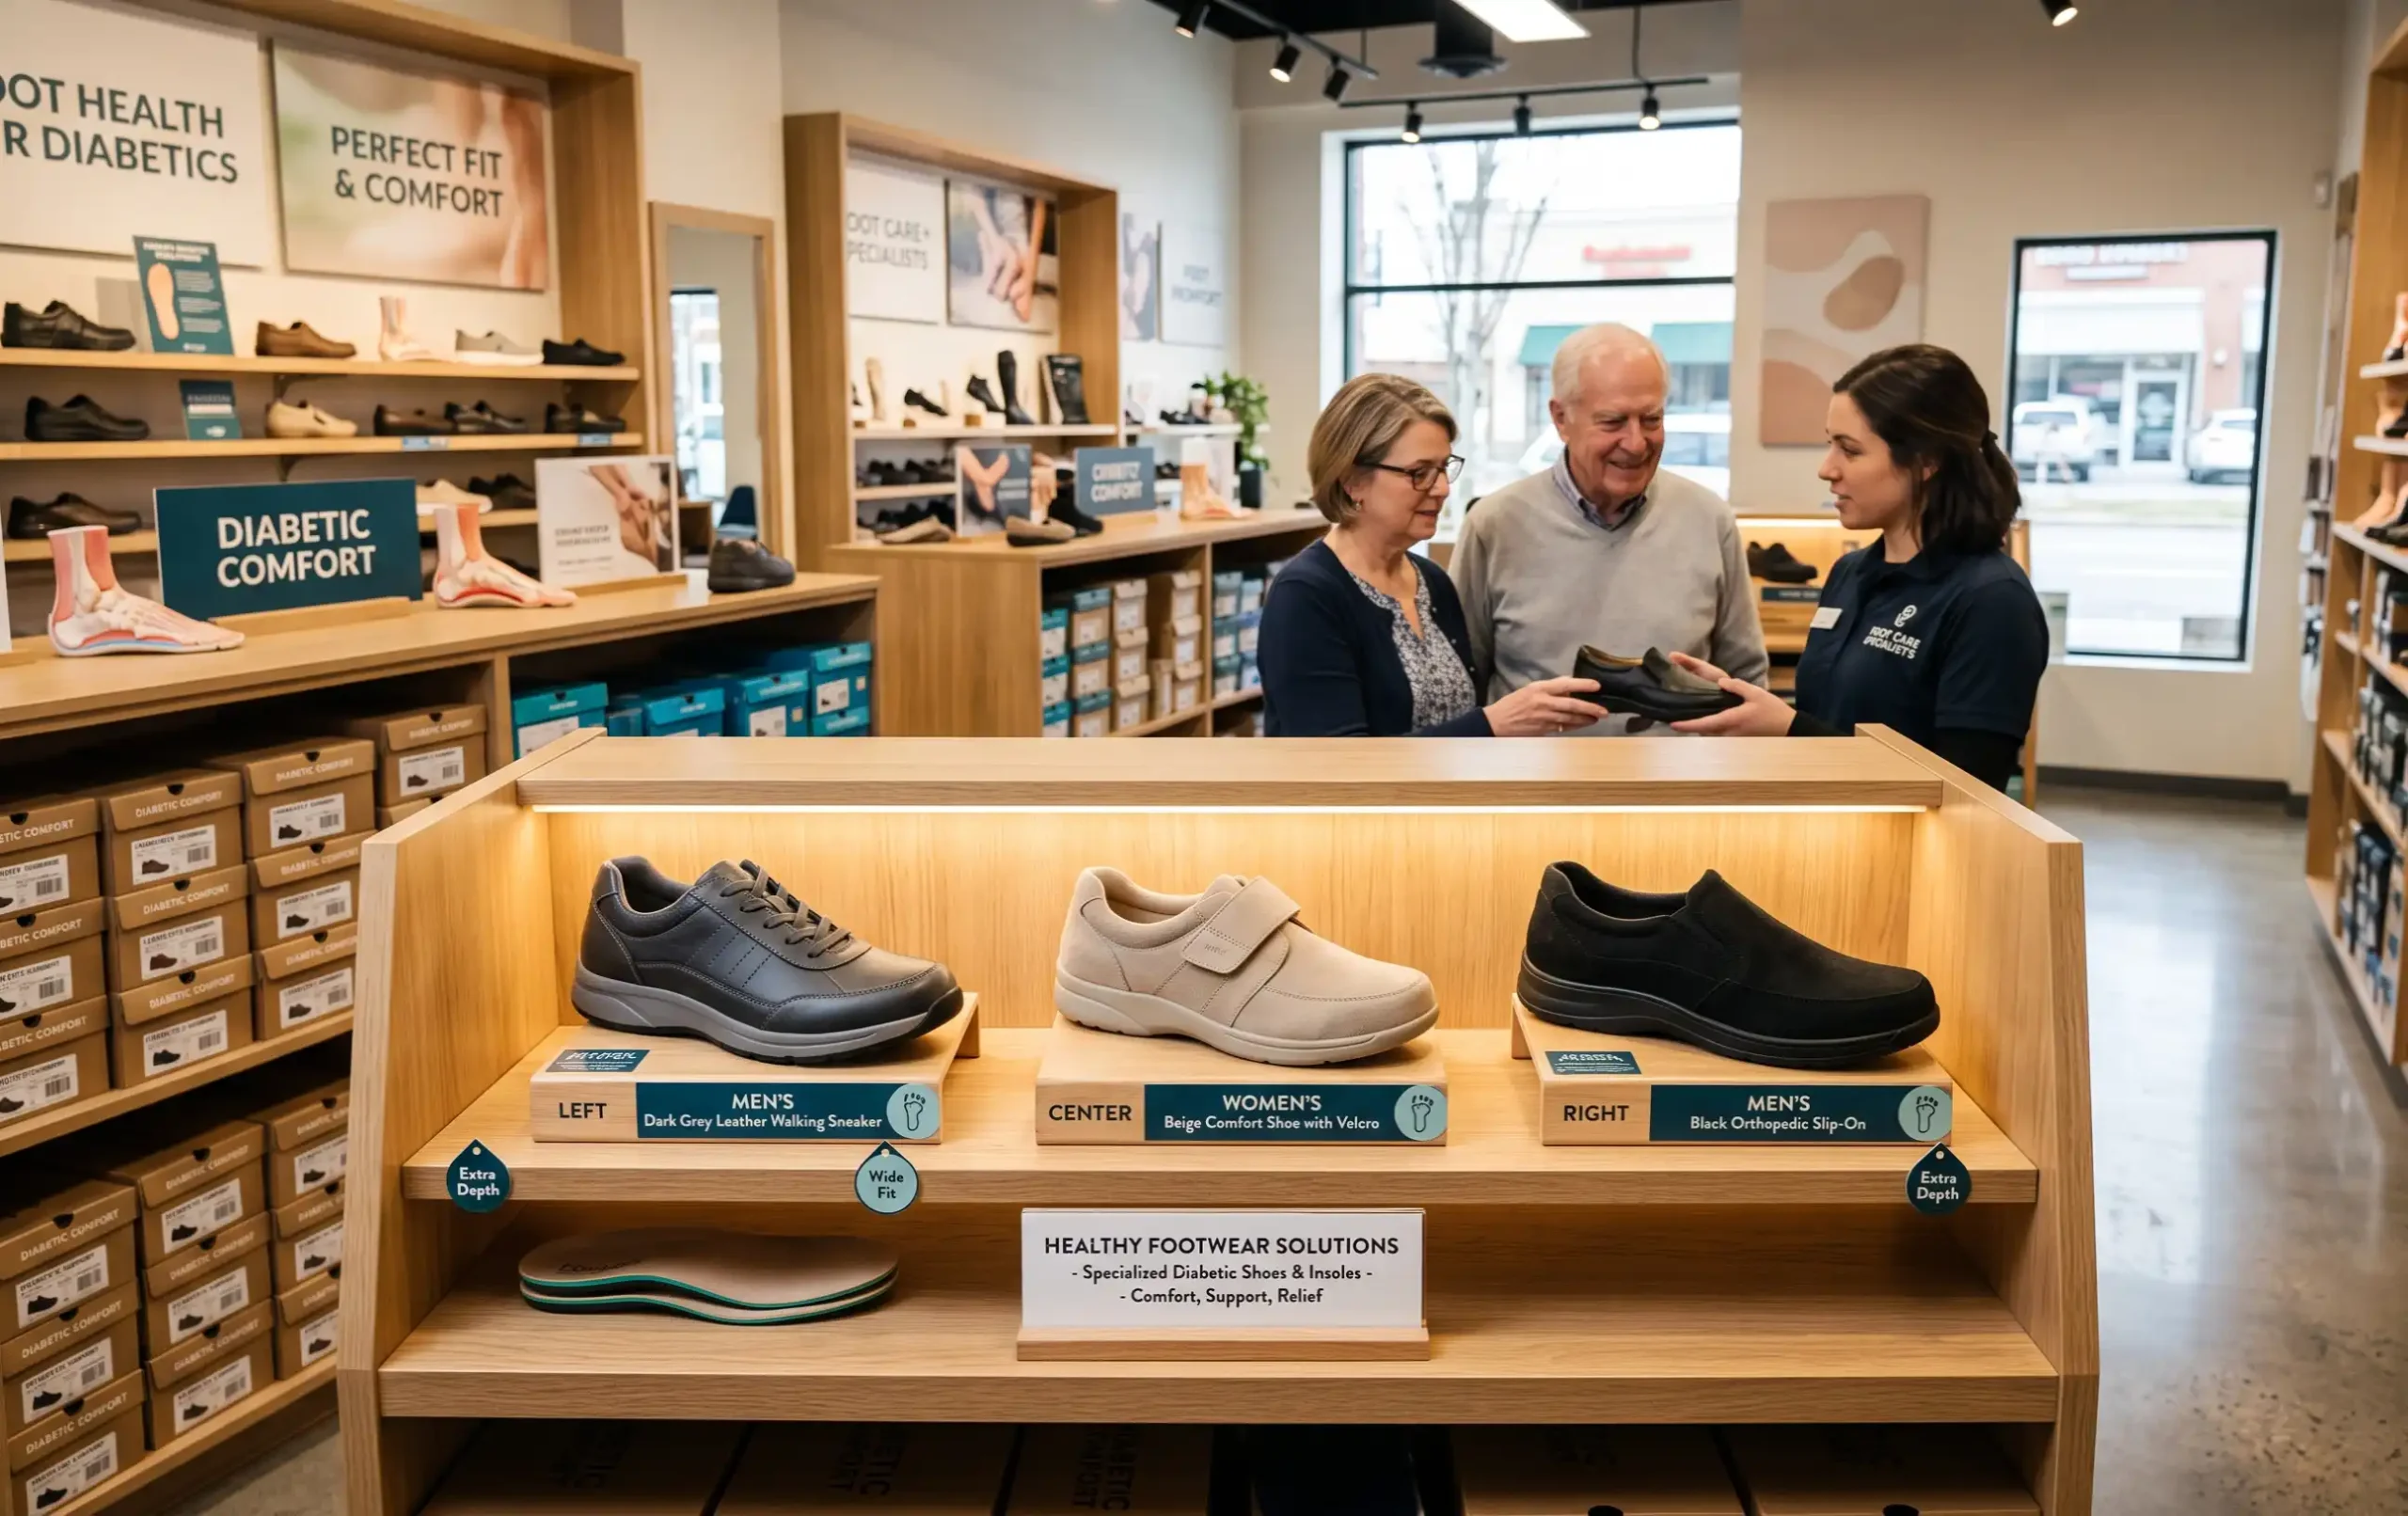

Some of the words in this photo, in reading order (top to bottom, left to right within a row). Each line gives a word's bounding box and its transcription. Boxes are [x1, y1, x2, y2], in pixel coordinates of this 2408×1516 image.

[0, 73, 65, 114] OT
[77, 84, 224, 139] HEALTH
[42, 125, 239, 184] DIABETICS
[331, 125, 456, 173] PERFECT
[465, 147, 503, 180] FIT
[335, 168, 356, 200] &
[365, 173, 504, 218] COMFORT
[217, 509, 372, 549] DIABETIC
[217, 545, 376, 588] COMFORT
[1893, 631, 1921, 650] CARE
[143, 895, 186, 915] DIABETIC
[32, 918, 83, 940] COMFORT
[0, 1033, 34, 1051] BETIC
[36, 1015, 88, 1039] COMFORT
[559, 1102, 608, 1119] LEFT
[732, 1093, 794, 1110] MEN’S
[1222, 1094, 1323, 1112] WOMEN’S
[1747, 1095, 1811, 1112] MEN’S
[643, 1113, 677, 1128] Dark
[679, 1114, 713, 1132] Grey
[716, 1113, 768, 1128] Leather
[770, 1113, 826, 1132] Walking
[828, 1113, 882, 1129] Sneaker
[1048, 1104, 1133, 1122] CENTER
[1562, 1104, 1630, 1122] RIGHT
[1164, 1114, 1202, 1134] Beige
[1205, 1114, 1263, 1129] Comfort
[1266, 1114, 1301, 1129] Shoe
[1304, 1115, 1334, 1129] with
[1336, 1115, 1380, 1129] Velcro
[1690, 1115, 1728, 1130] Black
[1731, 1115, 1810, 1135] Orthopedic
[1813, 1115, 1866, 1135] Slip-On
[458, 1166, 497, 1181] Extra
[868, 1169, 905, 1184] Wide
[1920, 1170, 1957, 1185] Extra
[456, 1181, 500, 1201] Depth
[877, 1185, 897, 1200] Fit
[1916, 1185, 1959, 1204] Depth
[21, 1232, 69, 1262] DIABETIC
[1045, 1237, 1143, 1255] HEALTHY
[1149, 1237, 1271, 1255] FOOTWEAR
[1275, 1237, 1400, 1255] SOLUTIONS
[1082, 1264, 1167, 1284] Specialized
[1172, 1264, 1237, 1280] Diabetic
[1242, 1264, 1287, 1280] Shoes
[1291, 1264, 1306, 1280] &
[1308, 1264, 1362, 1280] Insoles
[1131, 1287, 1201, 1307] Comfort,
[1205, 1287, 1273, 1309] Support,
[1277, 1287, 1325, 1303] Relief
[22, 1327, 71, 1359] DIABETIC
[25, 1421, 75, 1454] DIABETIC
